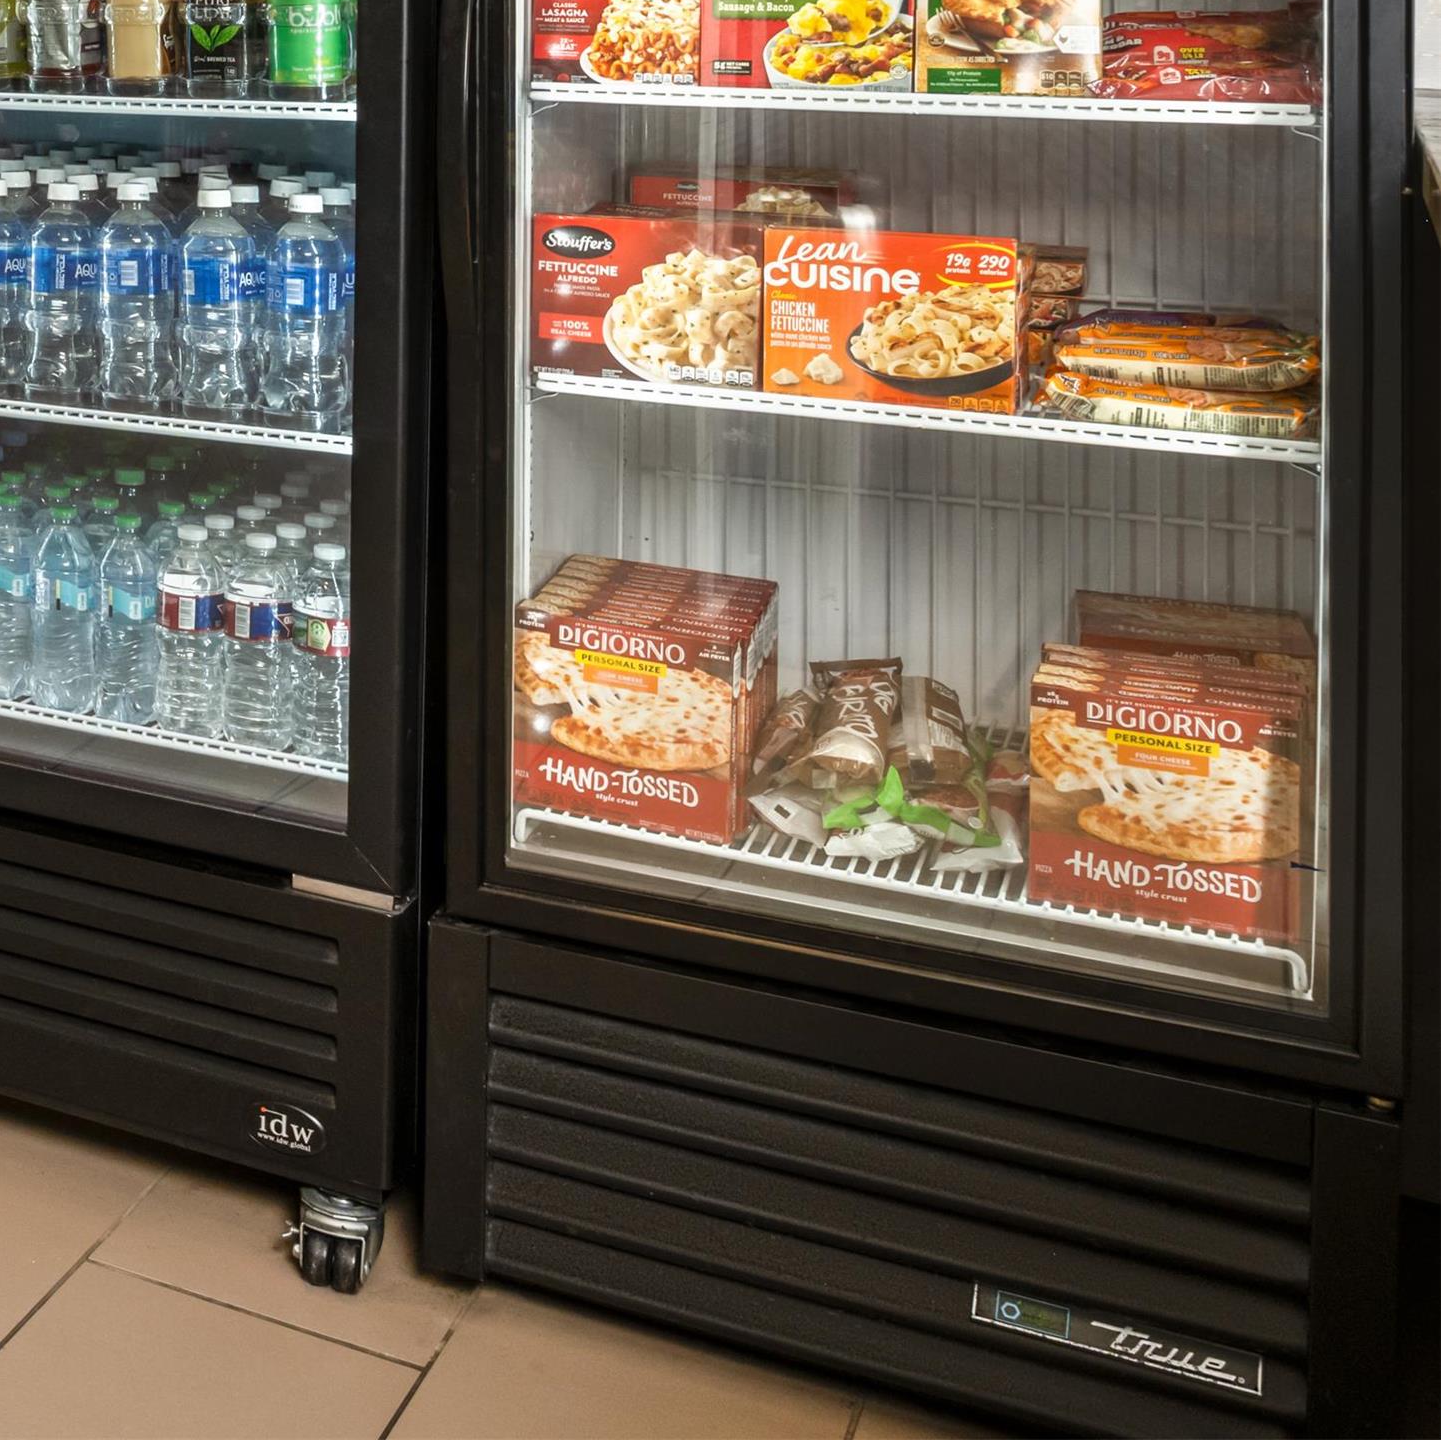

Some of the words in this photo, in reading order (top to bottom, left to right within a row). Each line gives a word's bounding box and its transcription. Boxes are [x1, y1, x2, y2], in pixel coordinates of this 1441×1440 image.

[542, 9, 589, 18] LASAGNA
[719, 2, 755, 14] Sausage
[766, 2, 795, 12] Bacon
[663, 192, 713, 202] FETTUCCINE
[545, 232, 612, 252] Stouffer's
[775, 235, 866, 266] Lean
[538, 260, 619, 277] FETTUCCINE
[978, 255, 1010, 269] 290
[945, 267, 971, 275] protein
[979, 269, 1008, 277] calories
[557, 274, 598, 284] ALFREDO
[771, 301, 816, 316] CHICKEN
[562, 320, 589, 330] 100%
[771, 315, 830, 334] FETTUCCINE
[551, 328, 567, 336] REAL
[568, 330, 591, 338] CHEESE
[559, 625, 686, 664] DIGIORNO
[581, 653, 635, 670] PERSONAL
[638, 663, 661, 674] SIZE
[1037, 696, 1069, 706] PROTEIN
[1086, 701, 1243, 744] DIGIORNO
[1114, 732, 1182, 750] PERSONAL
[1185, 742, 1212, 754] SIZE
[1135, 752, 1158, 761] FOUR
[1160, 755, 1191, 766] CHEESE
[539, 757, 699, 807] HAND-TOSSED
[596, 792, 615, 803] style
[616, 796, 638, 807] crust
[1035, 864, 1053, 874] PIZZA
[1064, 849, 1263, 903] HAND-TOSSED
[1135, 888, 1158, 899] style
[1161, 893, 1187, 903] crust
[259, 1107, 314, 1144] idw
[257, 1132, 311, 1152] www.idw.global
[1090, 1319, 1238, 1382] true
